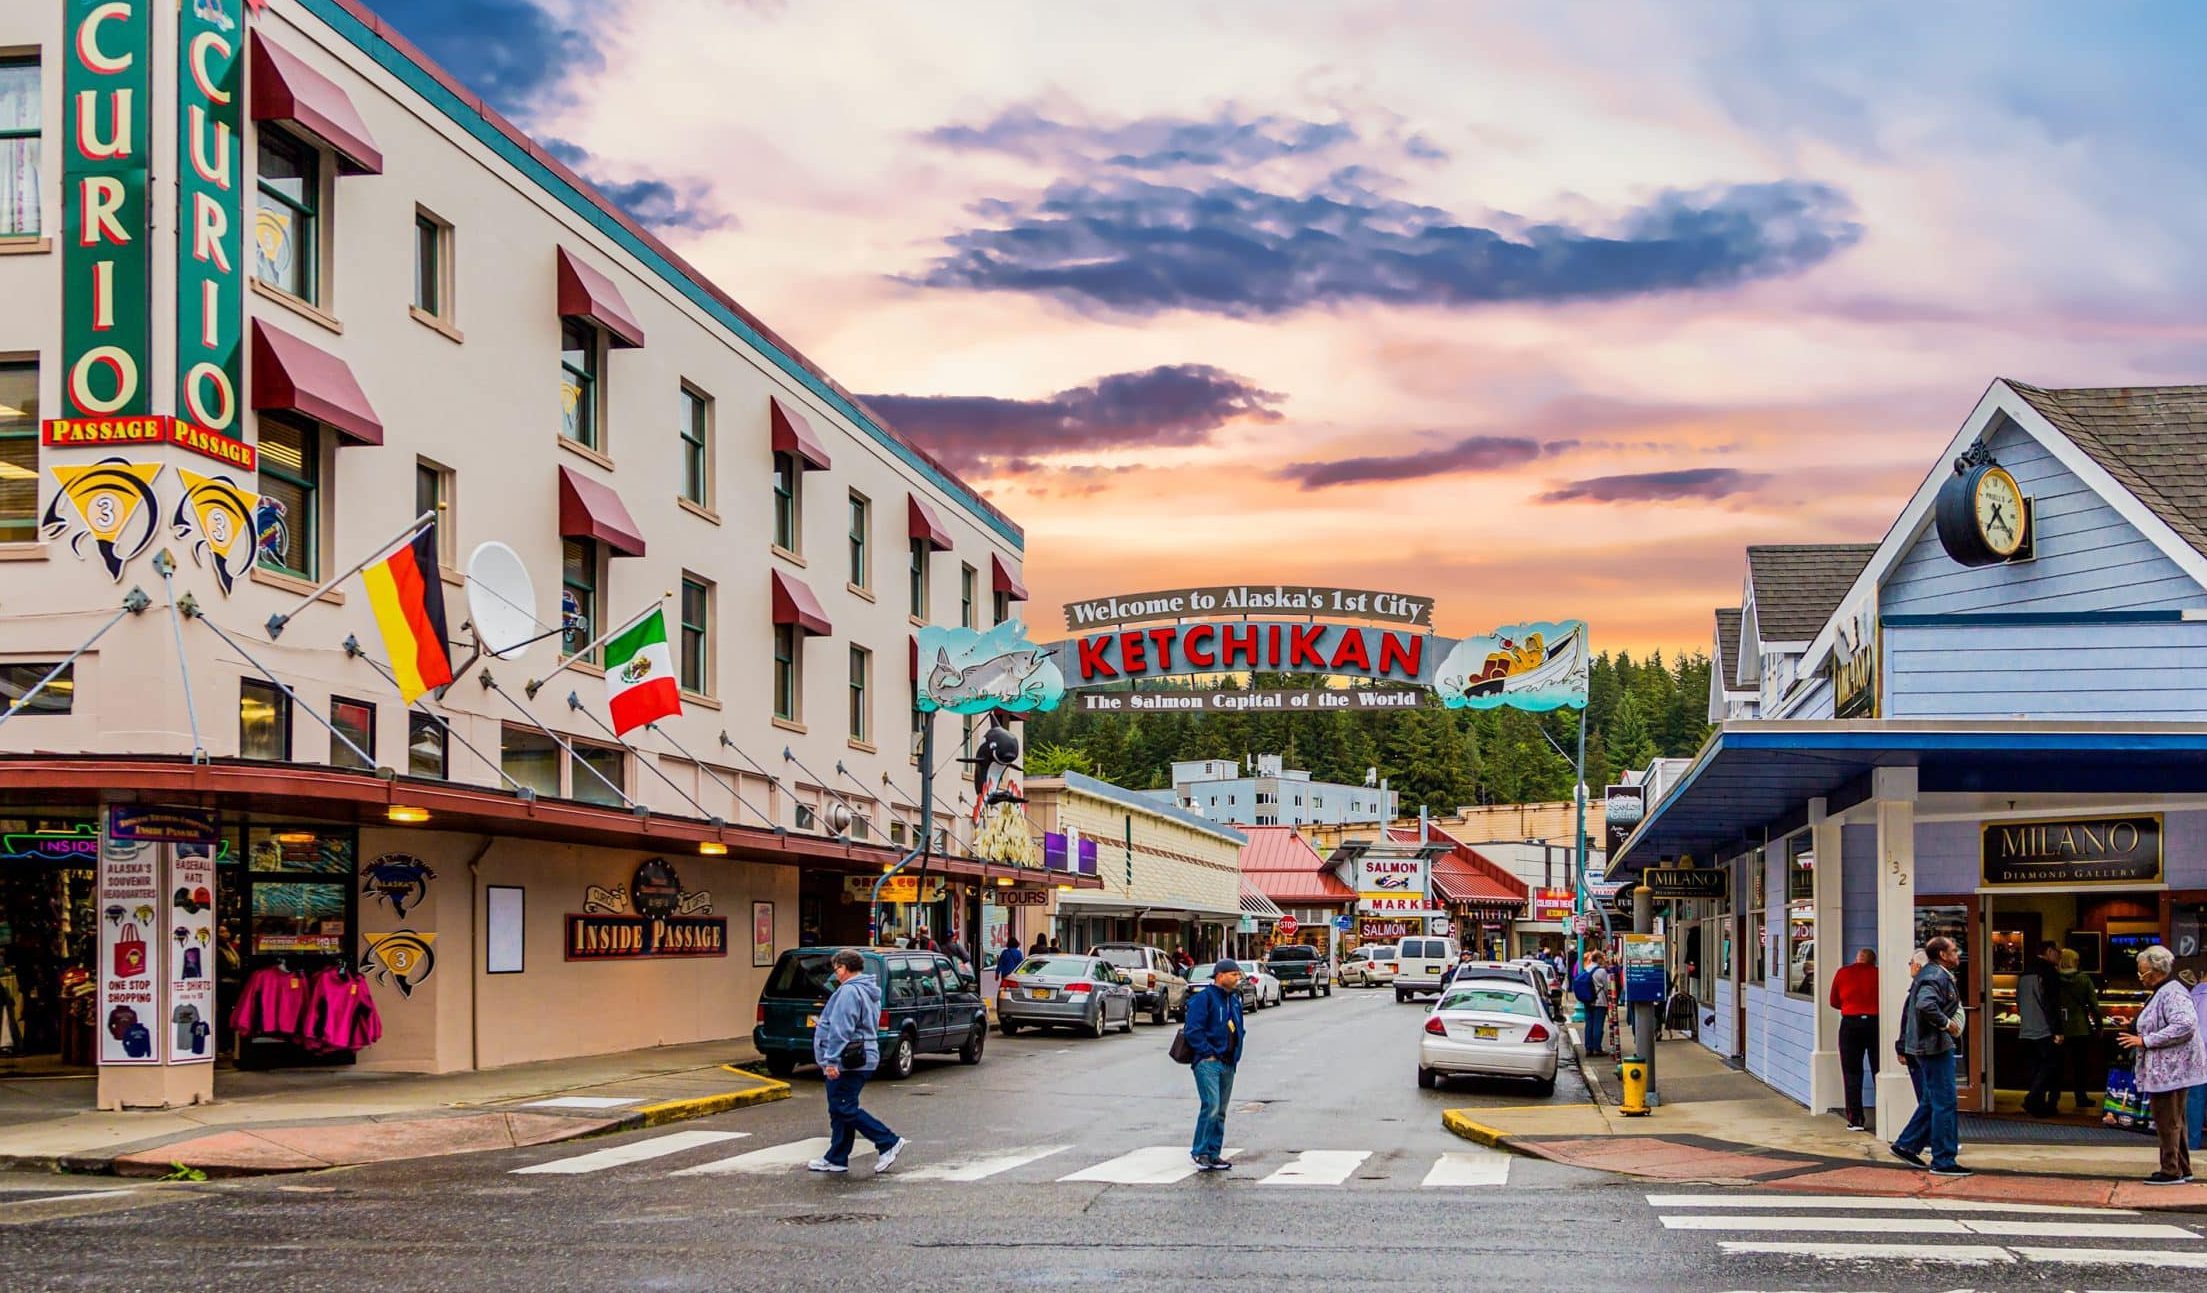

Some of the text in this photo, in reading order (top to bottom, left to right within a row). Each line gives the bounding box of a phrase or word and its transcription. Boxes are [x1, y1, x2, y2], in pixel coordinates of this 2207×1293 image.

[68, 2, 138, 416] CURIO
[183, 30, 235, 431] CURIO
[52, 420, 158, 442] PASSAGE
[175, 420, 252, 466] PASSAGE
[96, 496, 115, 528] 3
[210, 509, 226, 542] 3
[1073, 587, 1424, 624] Welcome to Alaska's 1st City
[1077, 624, 1423, 680] KETCHIKAN
[1084, 692, 1417, 711] The Salmon Capital of the World
[40, 841, 97, 852] INSIDE
[2001, 822, 2140, 858] MILANO
[107, 864, 152, 874] ALASKA'S
[175, 860, 211, 871] BASEBALL
[1366, 862, 1418, 873] SALMON
[108, 876, 151, 887] SOUVENIR
[1655, 871, 1718, 886] MILANO
[2003, 868, 2138, 881] DIAMOND GALLERY
[897, 876, 936, 888] CON
[103, 888, 156, 899] HEADQUARTERS
[999, 890, 1047, 904] TOURS
[1280, 921, 1297, 929] STOP
[1363, 923, 1406, 936] SALMON
[576, 919, 643, 952] INSIDE
[652, 919, 721, 951] PASSAGE
[395, 952, 407, 968] 3
[108, 980, 151, 990] ONE STOP
[187, 980, 211, 991] SHIRTS
[108, 993, 152, 1003] SHOPPING
